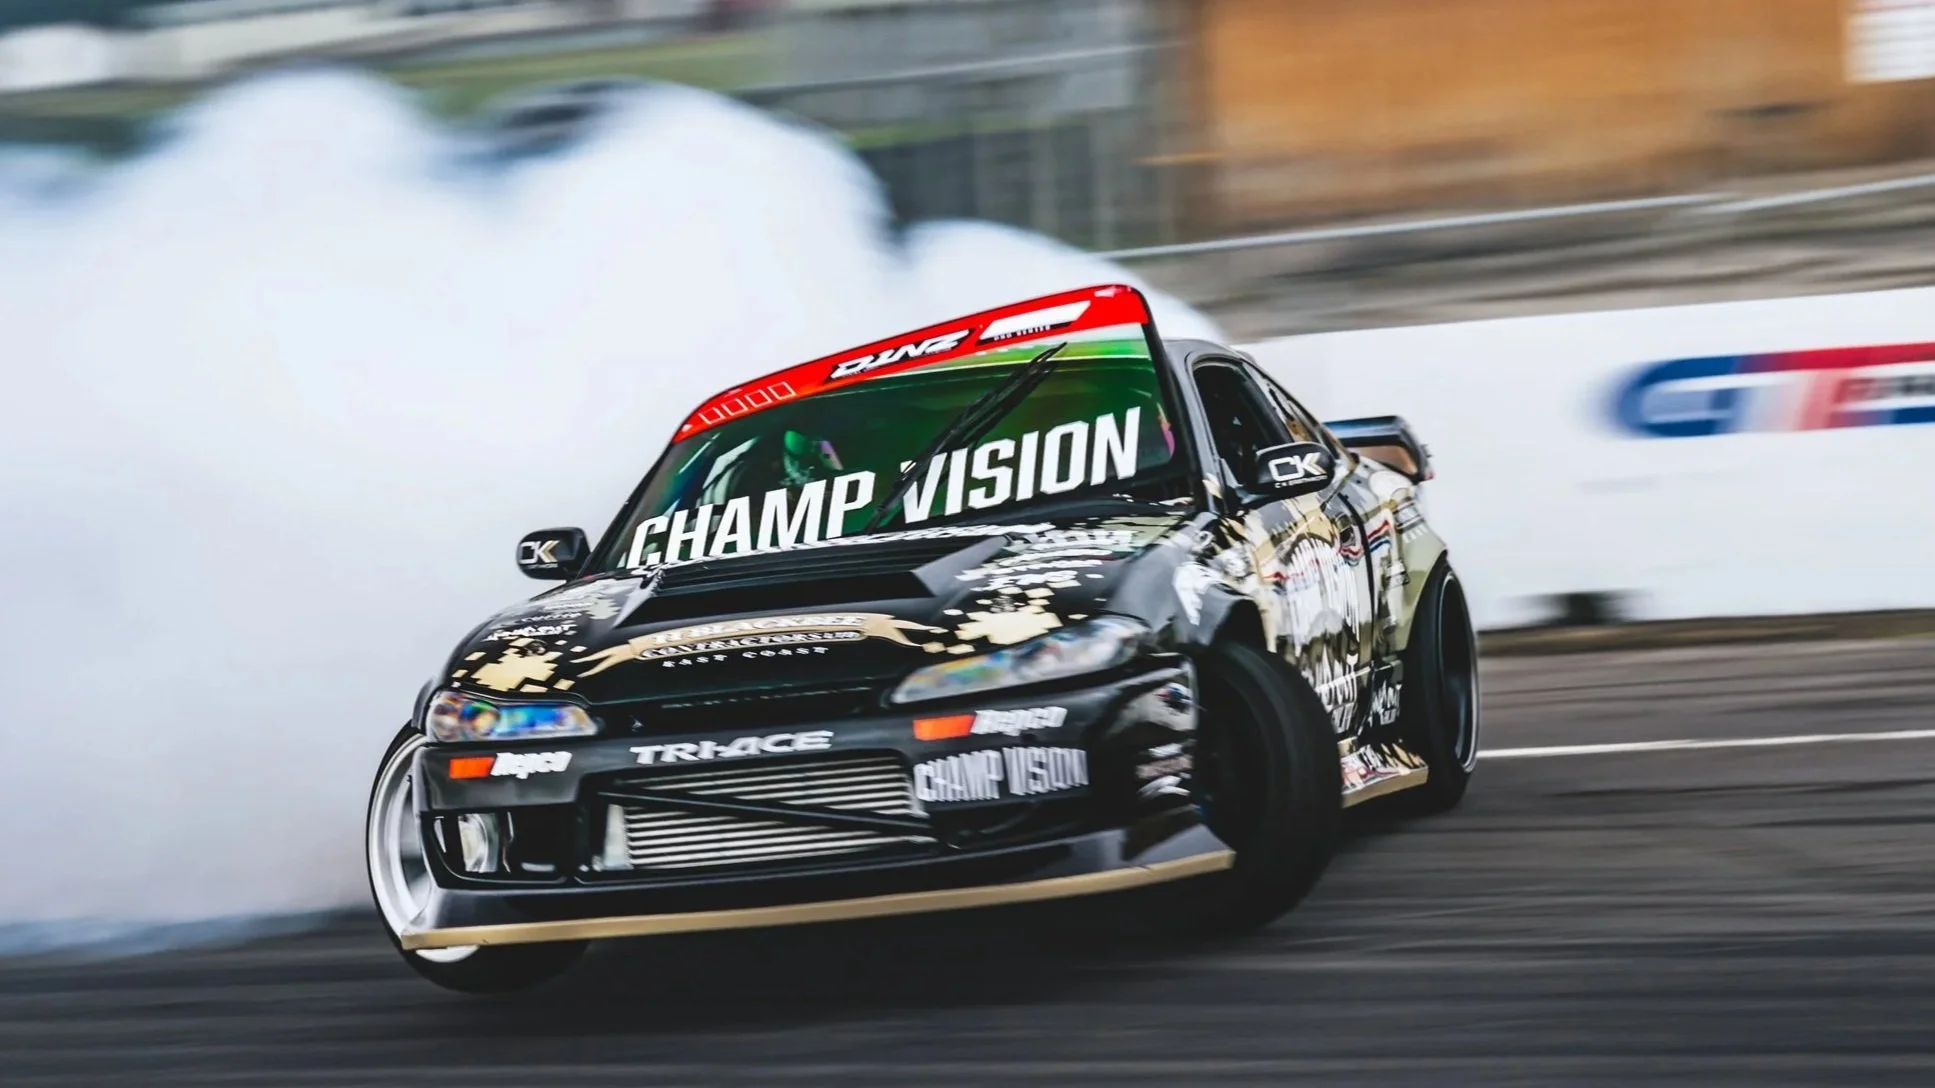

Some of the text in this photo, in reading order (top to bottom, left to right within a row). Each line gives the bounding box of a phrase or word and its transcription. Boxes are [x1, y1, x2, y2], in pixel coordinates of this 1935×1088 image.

[1268, 452, 1327, 481] CK
[626, 406, 1140, 569] CHAMP VISION
[519, 540, 560, 564] CK
[662, 646, 828, 668] EAST COAST
[914, 750, 1003, 801] CHAMP
[1003, 747, 1089, 795] VISION
